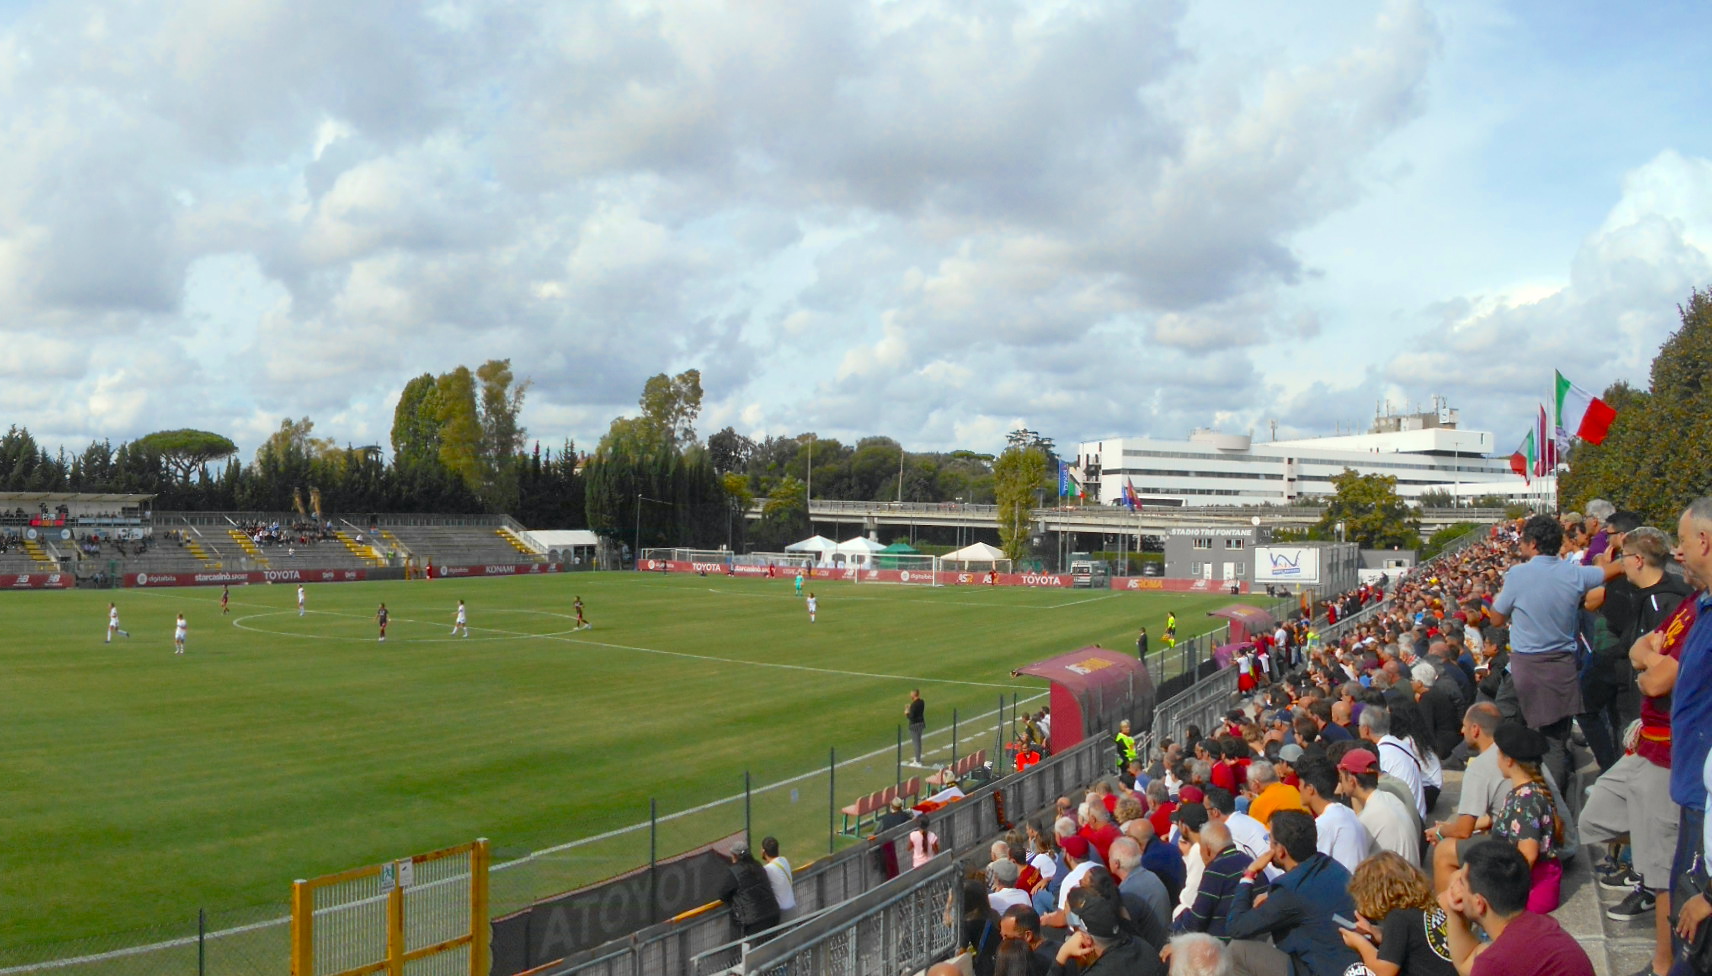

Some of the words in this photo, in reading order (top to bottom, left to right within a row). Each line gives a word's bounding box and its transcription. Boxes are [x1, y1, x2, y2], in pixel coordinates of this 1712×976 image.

[1172, 528, 1200, 536] STADIO
[485, 565, 516, 574] KONAMI
[692, 562, 722, 572] TOYOTA
[263, 570, 300, 580] TOYOTA
[1021, 575, 1061, 585] TOYOTA
